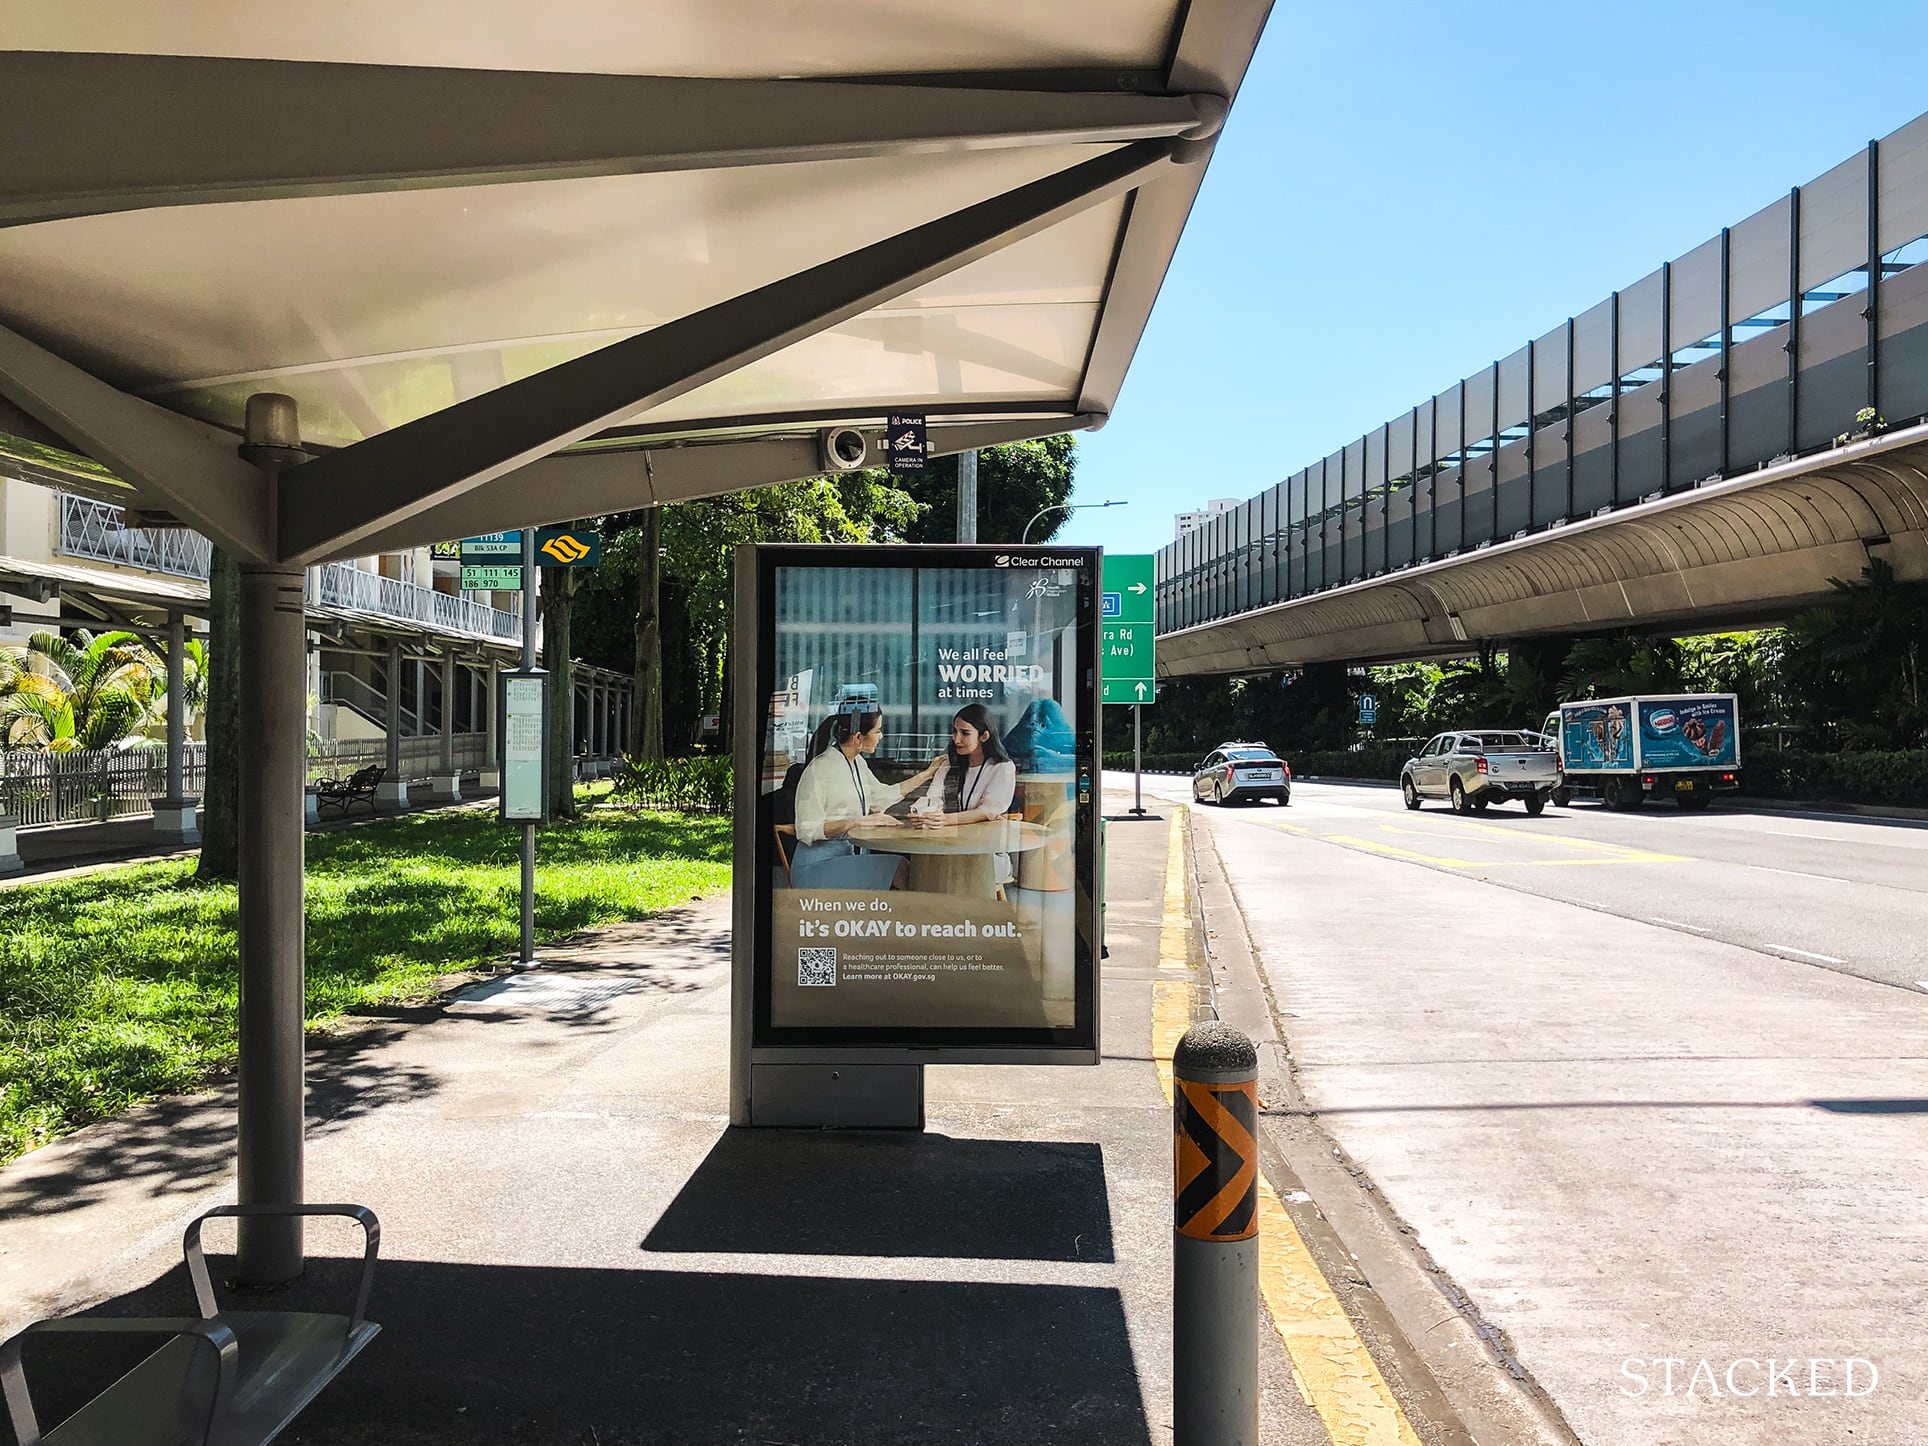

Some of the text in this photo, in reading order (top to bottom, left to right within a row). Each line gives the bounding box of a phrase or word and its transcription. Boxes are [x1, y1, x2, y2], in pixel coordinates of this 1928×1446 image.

[1011, 556, 1084, 567] Clear Channel
[464, 580, 499, 588] 186 970
[1104, 629, 1133, 640] ra Rd
[938, 648, 1009, 661] We all feel
[1110, 644, 1134, 656] Ave)
[938, 665, 1044, 683] WORRIED
[938, 686, 994, 699] at times
[1103, 685, 1110, 696] d
[1679, 706, 1696, 715] Indulge
[799, 898, 892, 913] When we do,
[799, 920, 1022, 938] it's OKAY to reach out.
[893, 973, 936, 981] OKAY.gov.sg
